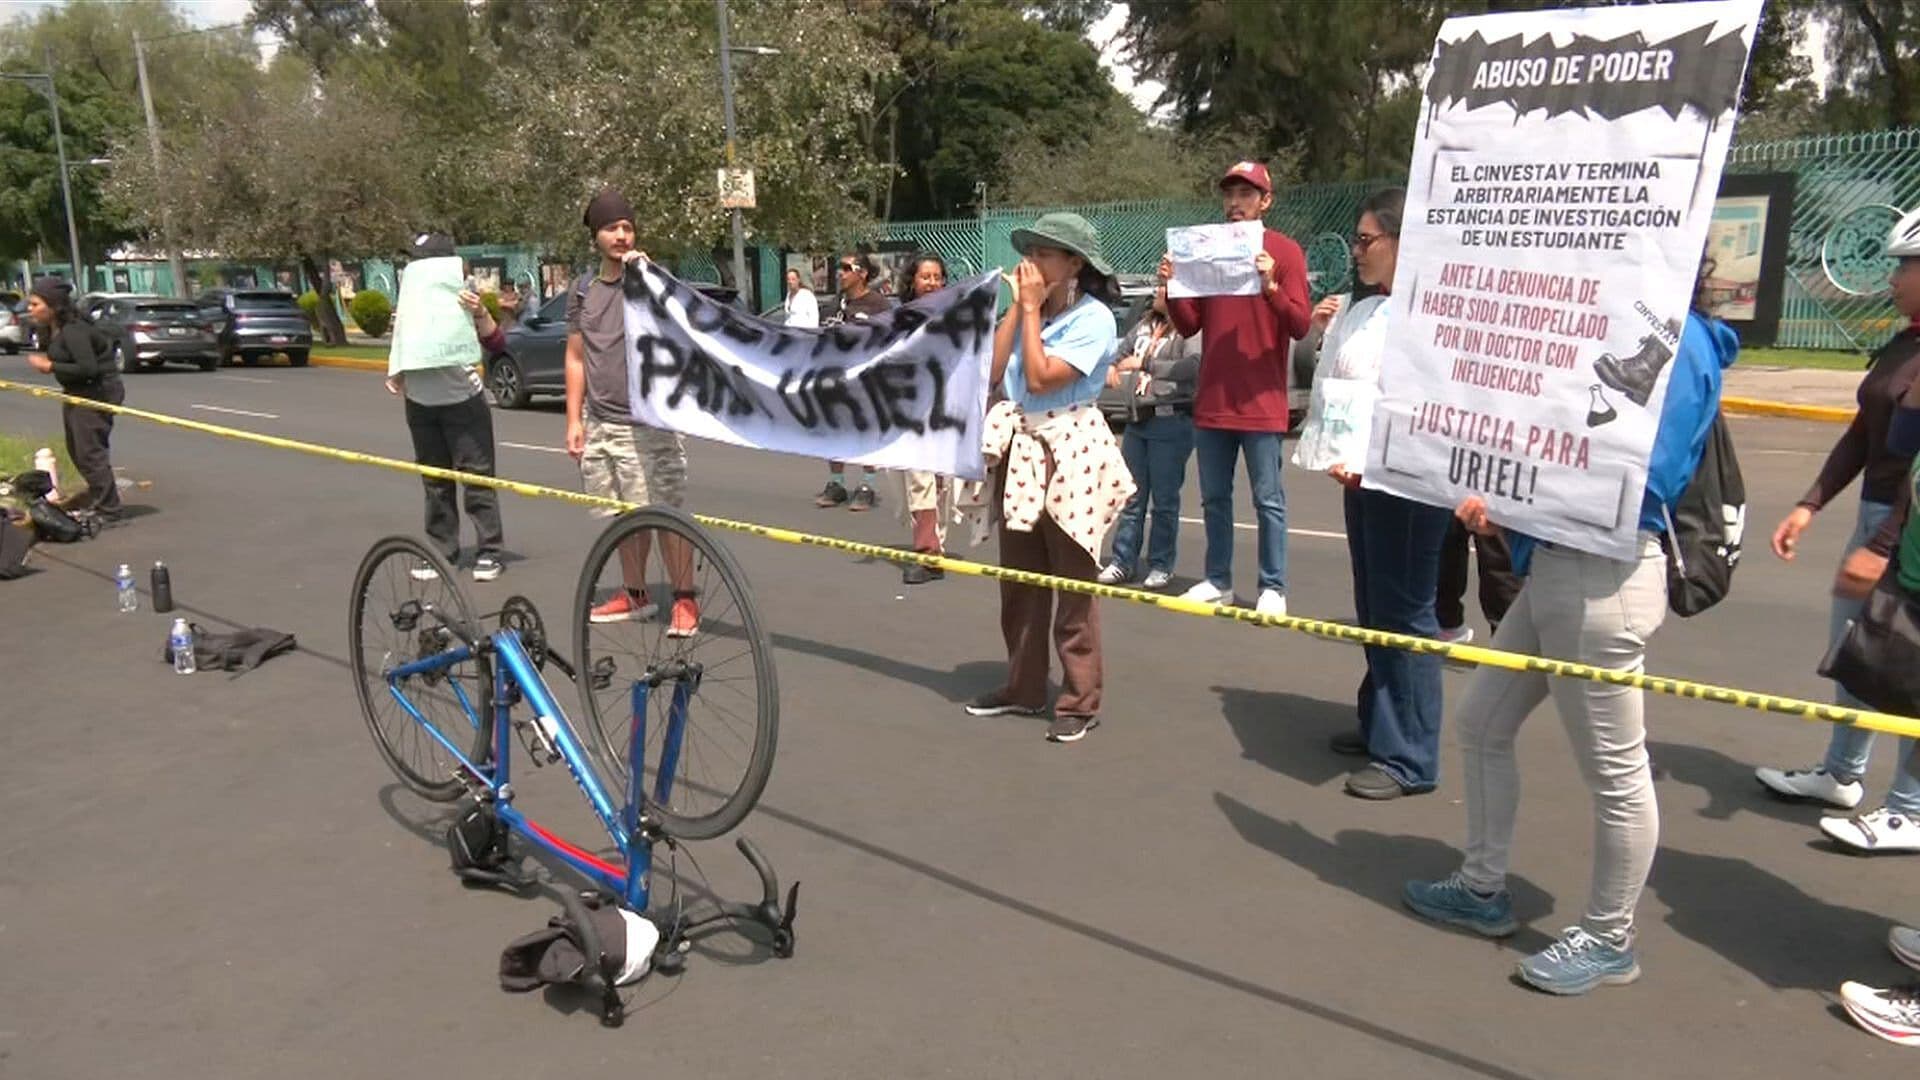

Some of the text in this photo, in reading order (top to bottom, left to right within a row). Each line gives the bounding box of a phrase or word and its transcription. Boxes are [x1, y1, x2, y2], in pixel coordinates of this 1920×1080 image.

[1472, 49, 1674, 89] ABUSO DE PODER
[1451, 161, 1661, 183] EL CINVESTAV TERMINA
[1453, 186, 1649, 204] ARBITRARIAMENTE LA
[1426, 205, 1681, 228] ESTANCIA DE INVESTIGACIÓN
[1461, 230, 1627, 250] DE UN ESTUDIANTE
[1439, 262, 1601, 305] ANTE LA DENUNCIA DE
[1421, 290, 1609, 341] HABER SIDO ATROPELLADO
[1433, 323, 1578, 370] POR UN DOCTOR CON
[777, 355, 967, 437] URIEL
[1451, 357, 1544, 397] INFLUENCIAS
[1409, 401, 1590, 470] ¡JUSTICIA PARA
[1449, 446, 1538, 505] URIEL!
